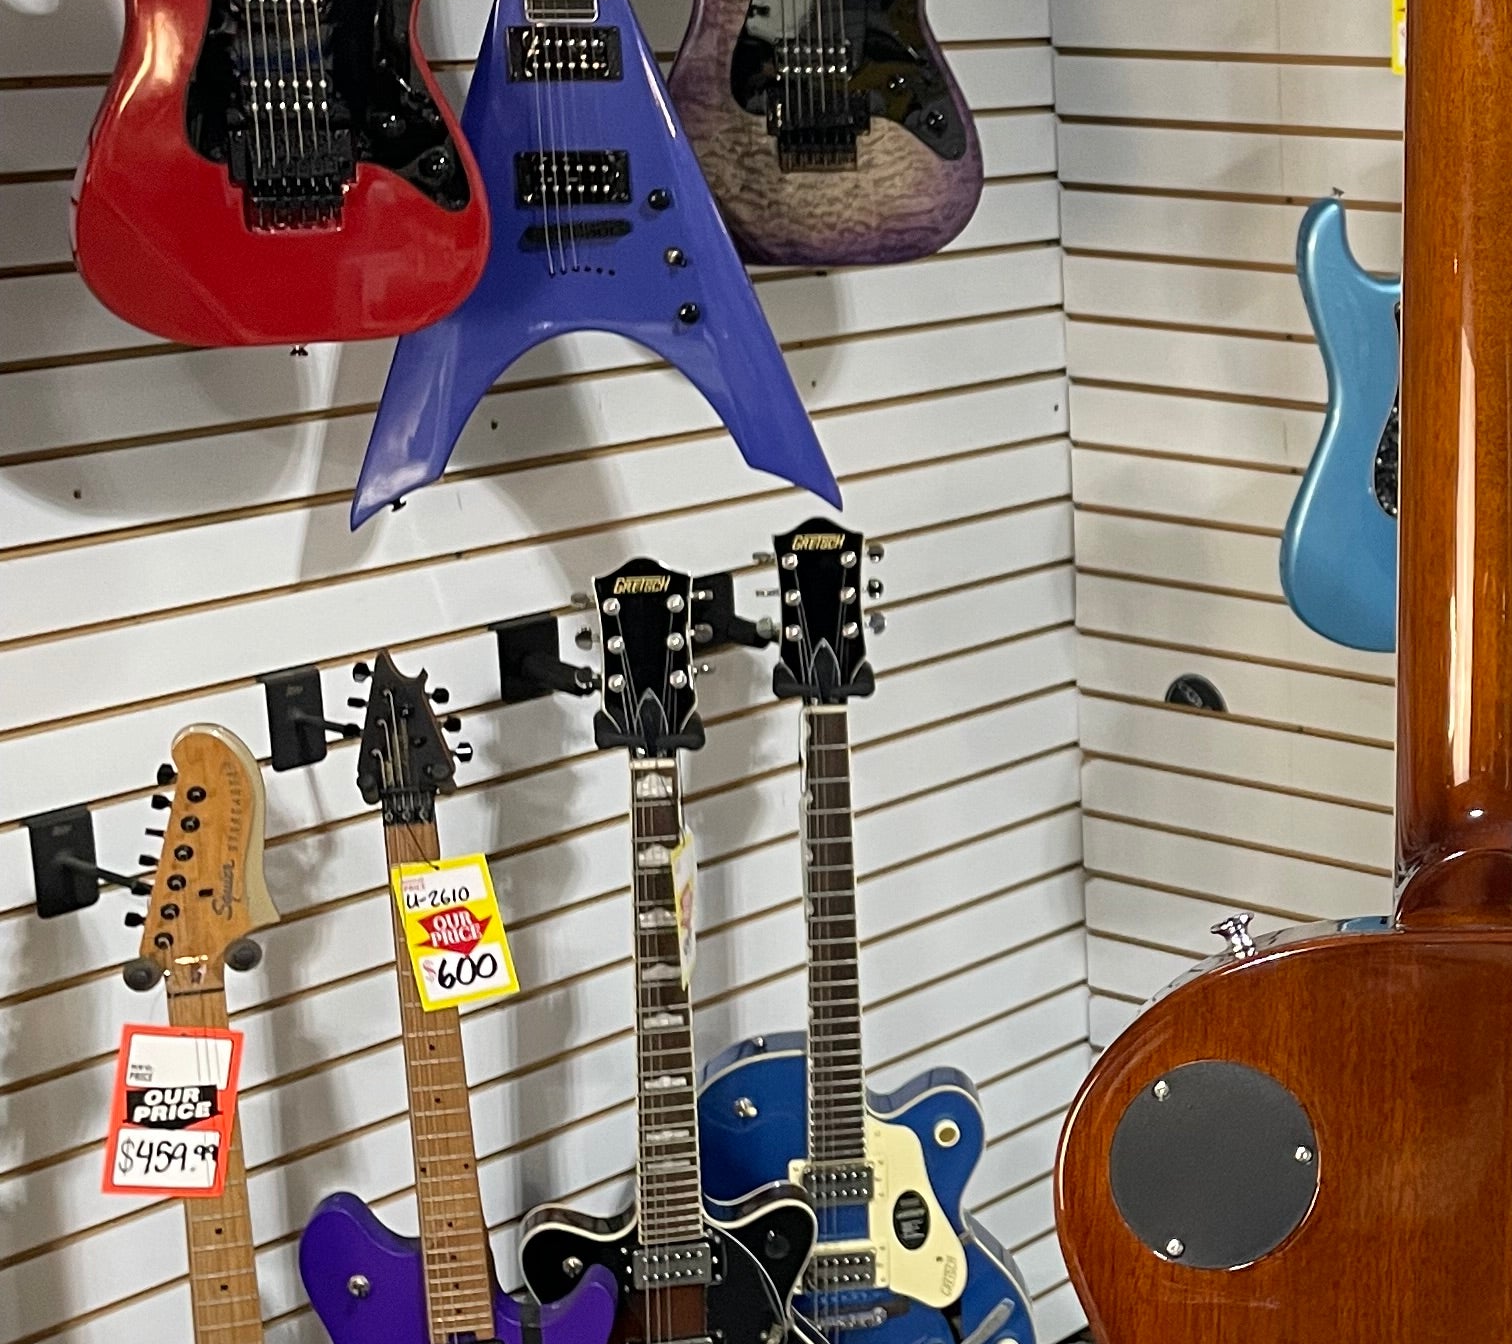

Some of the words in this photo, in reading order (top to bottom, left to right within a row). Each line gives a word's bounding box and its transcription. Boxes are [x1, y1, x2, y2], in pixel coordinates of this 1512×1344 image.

[791, 532, 846, 551] GRETSCH
[613, 574, 672, 595] GRETSCH
[406, 886, 470, 909] U-2610
[432, 909, 473, 933] OUR
[430, 922, 483, 949] PRICE
[423, 953, 498, 990] $600
[144, 1087, 201, 1106] OUR
[133, 1101, 212, 1123] PRICE
